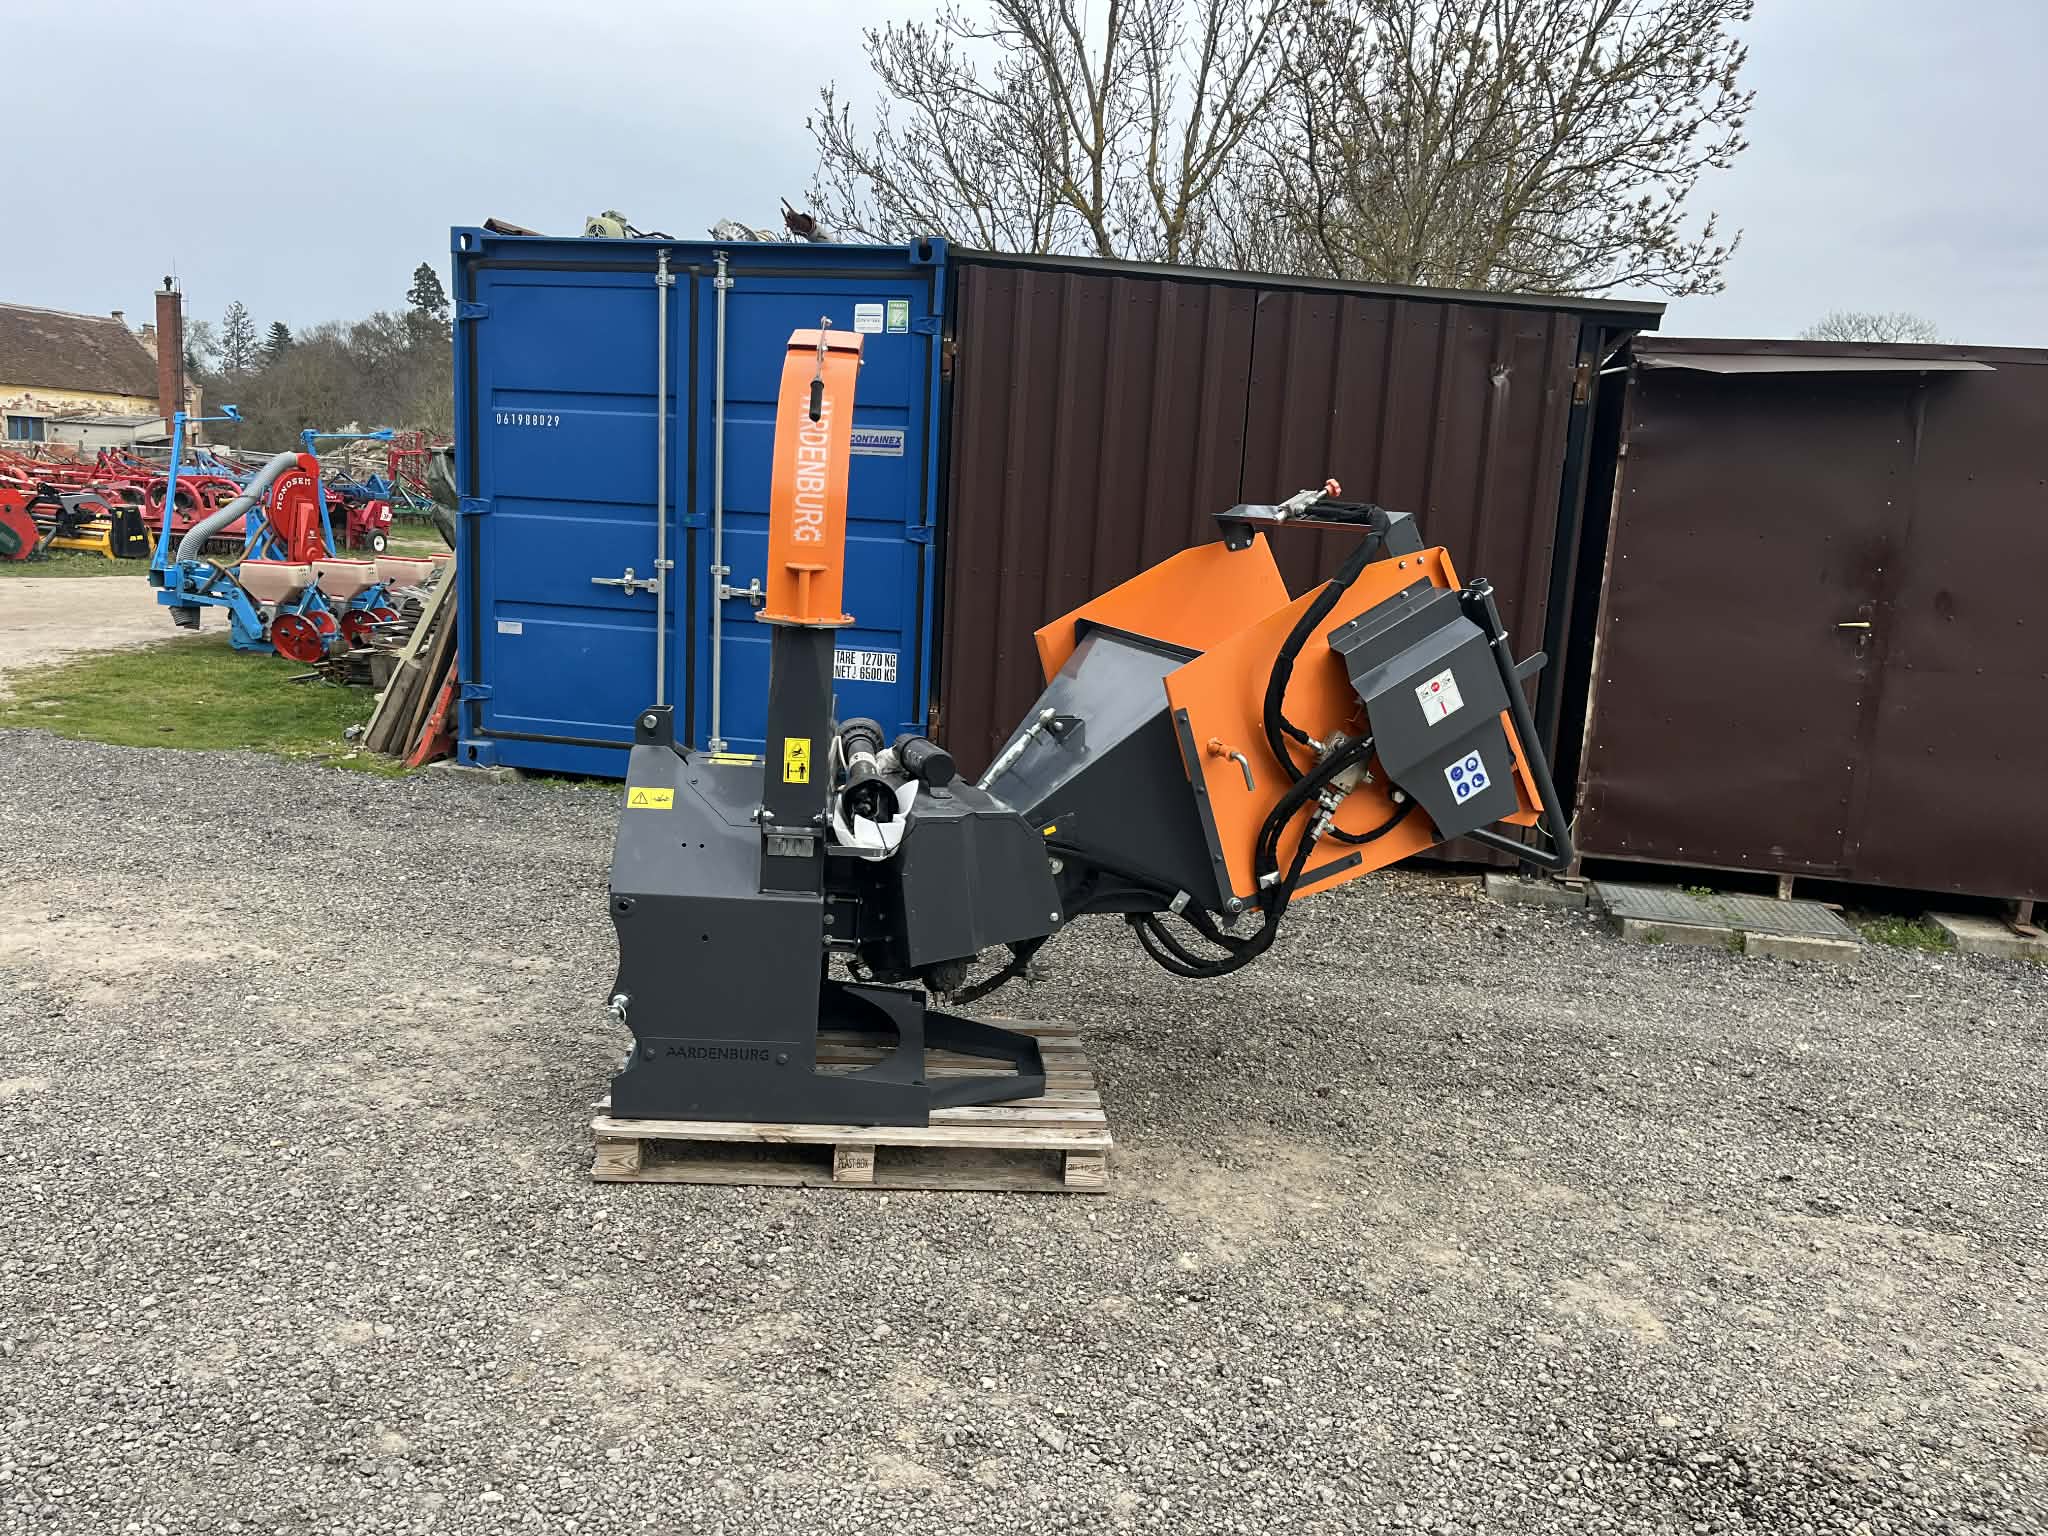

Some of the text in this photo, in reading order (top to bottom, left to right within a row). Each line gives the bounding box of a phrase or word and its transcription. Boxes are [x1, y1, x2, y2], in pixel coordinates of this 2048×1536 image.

[496, 412, 560, 427] 061988029
[276, 477, 311, 511] MONOSEM
[835, 650, 896, 667] TARE 1270 KG
[860, 666, 882, 680] 6500
[884, 668, 896, 681] KG
[665, 1046, 769, 1061] AARDENBURG
